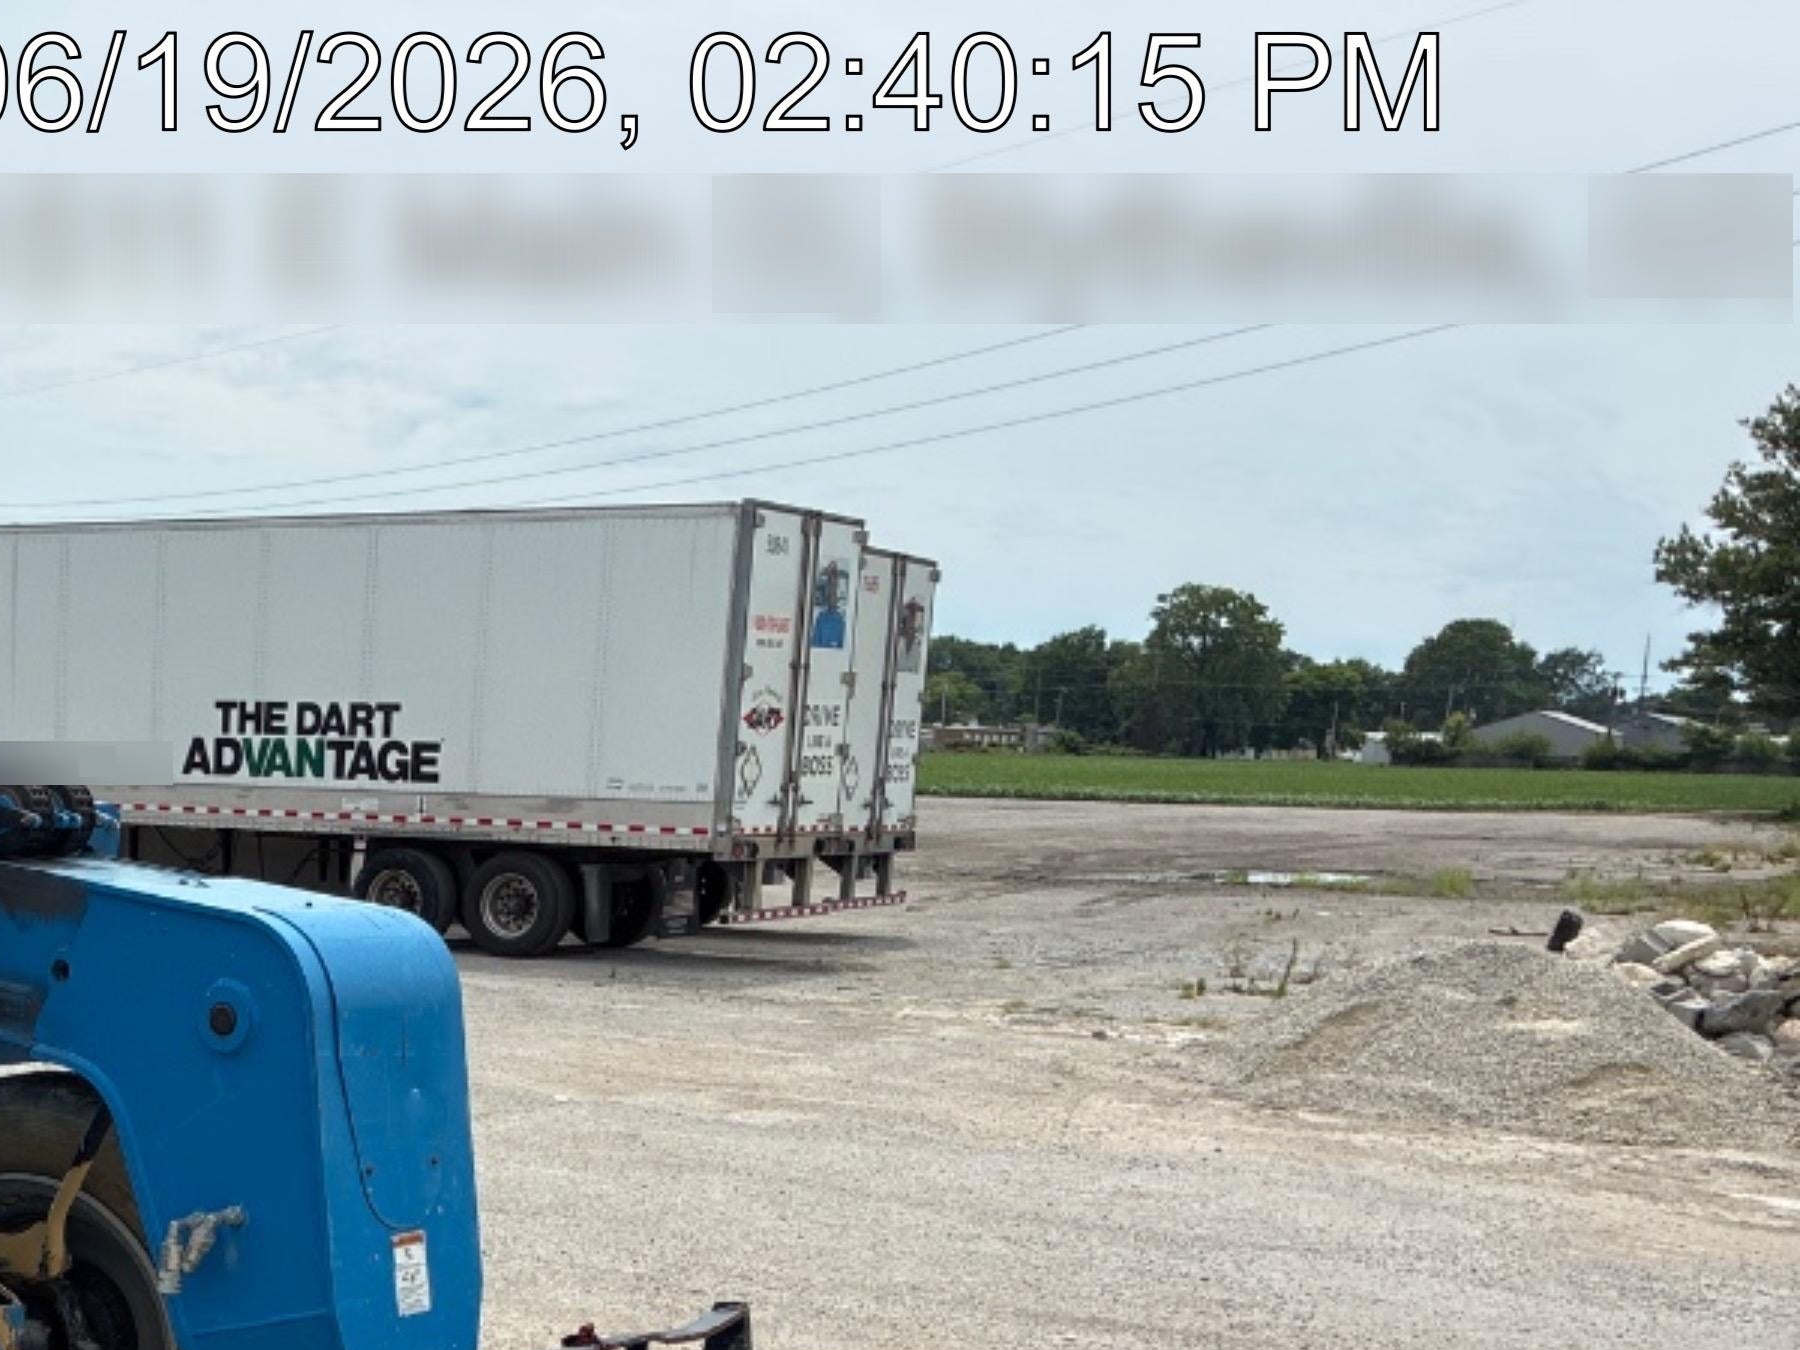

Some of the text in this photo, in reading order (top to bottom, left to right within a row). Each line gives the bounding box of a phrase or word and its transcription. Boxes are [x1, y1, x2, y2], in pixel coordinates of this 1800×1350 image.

[215, 701, 401, 738] THE DART
[182, 737, 441, 783] ADVANTAGE
